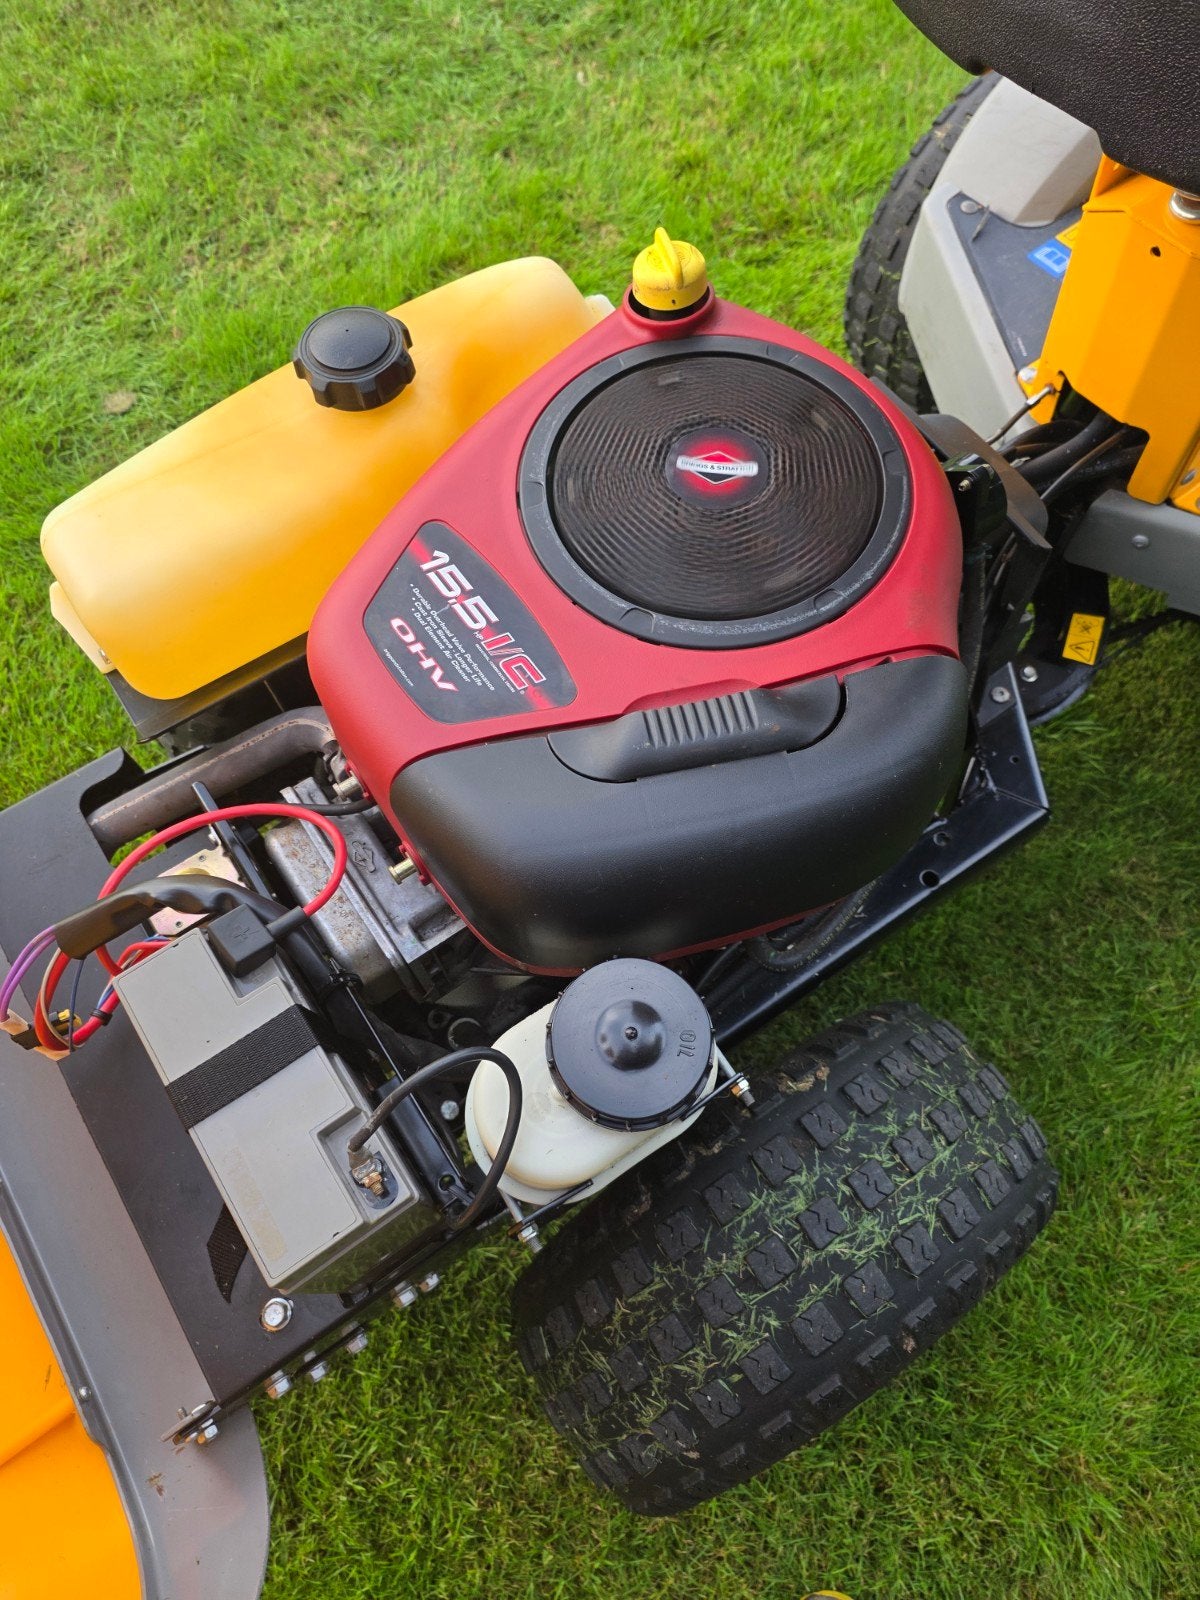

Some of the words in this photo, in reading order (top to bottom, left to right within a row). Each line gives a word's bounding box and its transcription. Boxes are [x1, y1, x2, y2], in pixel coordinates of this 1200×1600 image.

[419, 550, 500, 630] 15.5
[389, 617, 460, 692] OHV
[412, 587, 431, 611] Durable
[430, 610, 454, 637] Overhead
[452, 637, 465, 653] Valve
[464, 653, 495, 691] Performance
[413, 612, 428, 626] Dual
[425, 626, 445, 650] Element
[442, 650, 453, 659] Air
[451, 660, 471, 682] Cleaner
[414, 602, 428, 616] Cast
[426, 616, 438, 629] Iron
[436, 629, 453, 649] Sleeve
[454, 653, 473, 674] Longer
[471, 674, 482, 686] Life
